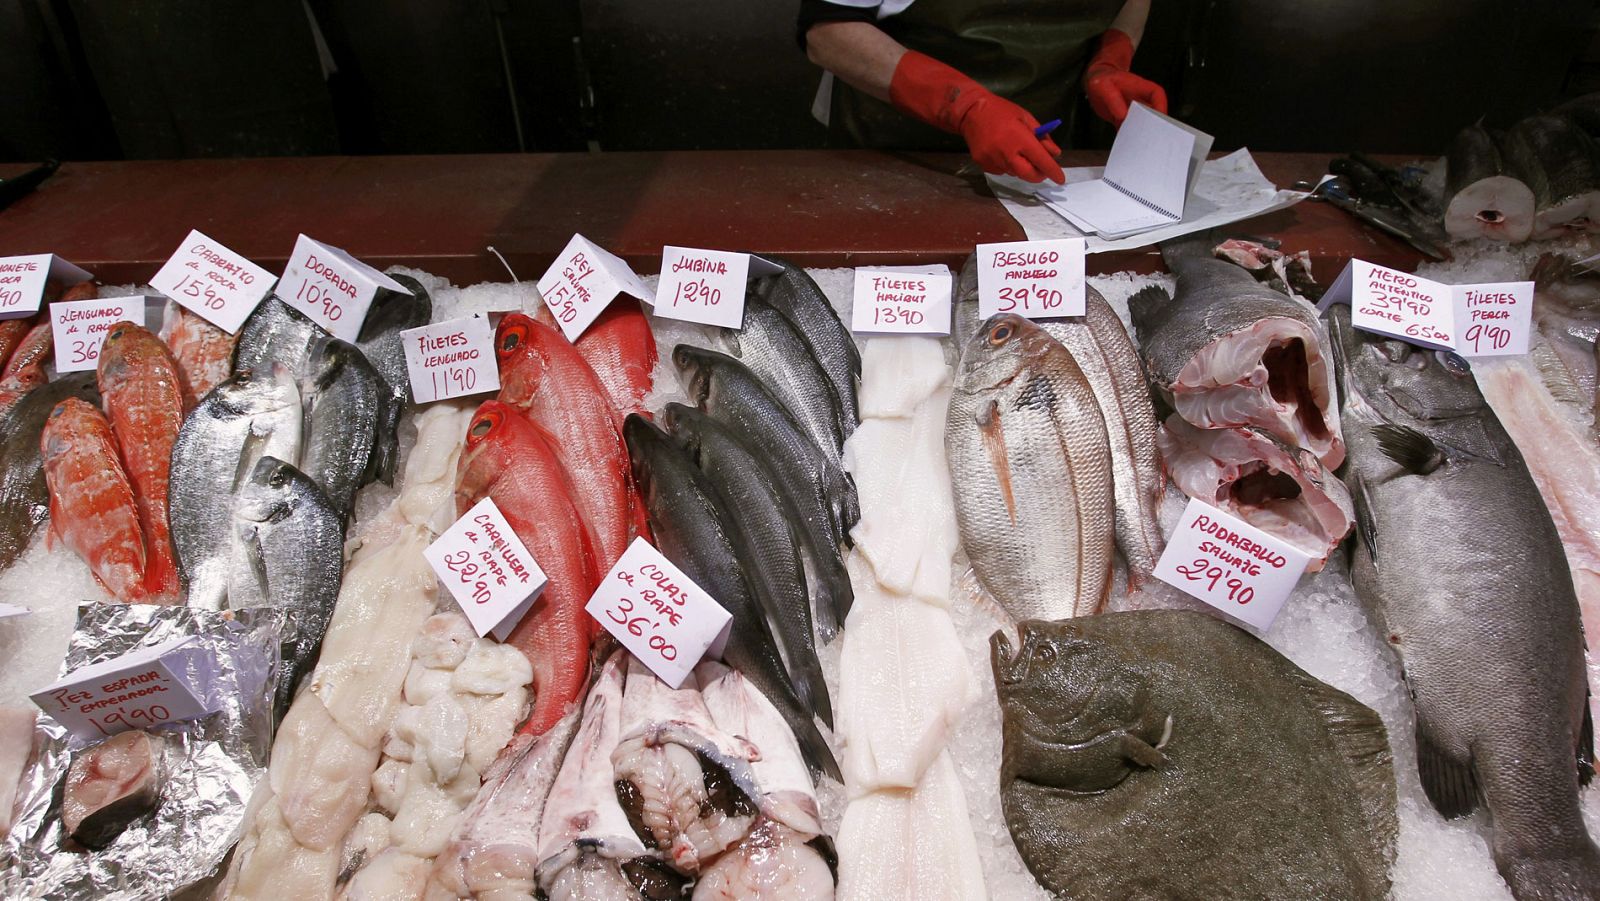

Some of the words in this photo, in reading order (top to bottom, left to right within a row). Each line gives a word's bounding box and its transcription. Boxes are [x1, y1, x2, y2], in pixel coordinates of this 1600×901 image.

[570, 252, 595, 280] REY
[672, 255, 727, 275] LUBINA
[992, 251, 1059, 268] BESUGO
[205, 270, 238, 291] ROCA
[304, 254, 357, 298] DORADA
[872, 276, 926, 291] FILETES
[1369, 267, 1417, 288] MERO
[296, 278, 342, 321] 10'90
[543, 281, 577, 323] 15'90
[673, 278, 721, 307] 12'90
[876, 292, 926, 303] HALIBUT
[998, 283, 1063, 312] 39'90
[1369, 291, 1431, 316] 39'90
[1465, 289, 1516, 308] FILETES
[60, 307, 123, 324] LENGUADO
[874, 306, 924, 325] 13'90
[1359, 307, 1404, 323] CORTE
[1405, 323, 1450, 341] 65'00
[1471, 309, 1510, 322] PERCA
[418, 331, 468, 355] FILETES
[1465, 324, 1511, 353] 9'90
[424, 349, 479, 368] LENGUADO
[432, 366, 476, 399] 11'90
[1191, 514, 1286, 568] RODABALLO
[444, 550, 492, 604] 22'90
[478, 551, 507, 587] RAPE
[1176, 559, 1254, 605] 29'90
[639, 564, 688, 607] COLAS
[640, 589, 683, 627] RAPE
[606, 598, 677, 661] 36'00
[102, 670, 161, 693] ESPADA
[80, 684, 168, 713] EMPERADOR
[88, 705, 170, 735] 19'90
